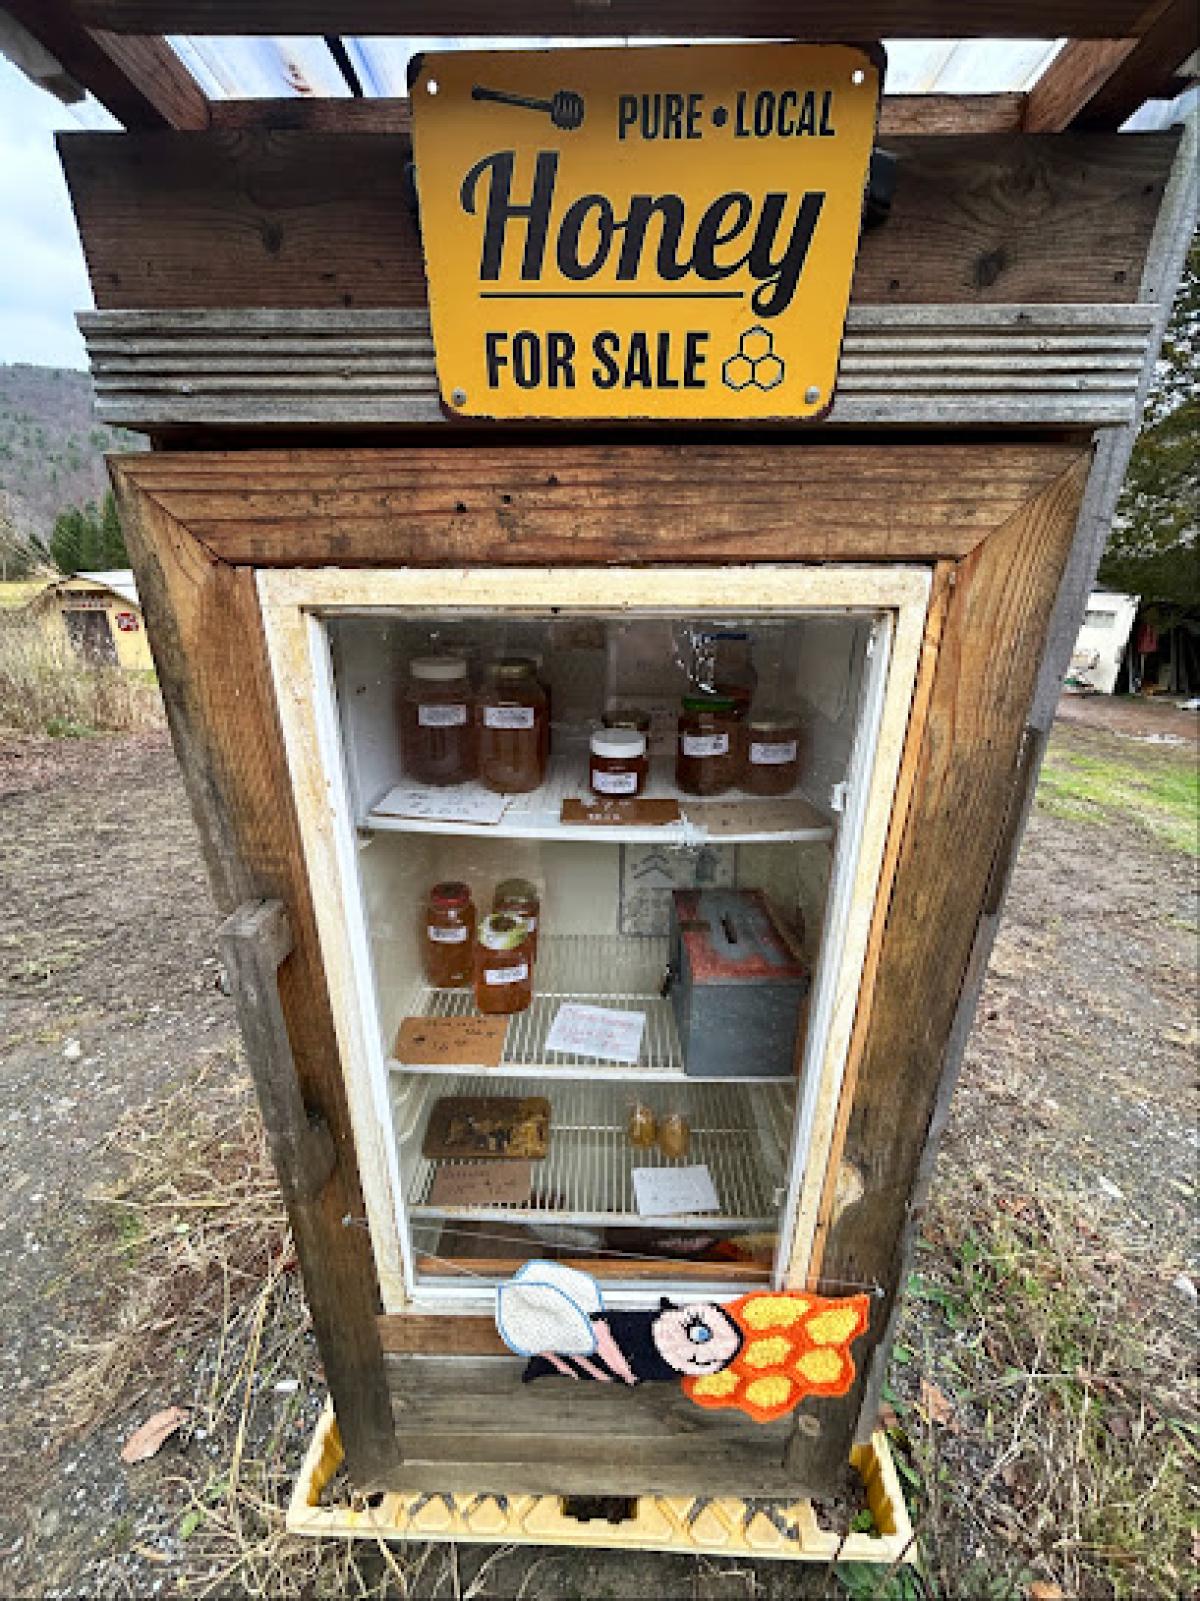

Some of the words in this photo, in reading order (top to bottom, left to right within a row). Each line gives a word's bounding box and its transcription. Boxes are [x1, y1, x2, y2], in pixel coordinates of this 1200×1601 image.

[618, 93, 704, 140] PURE
[735, 91, 835, 137] LOCAL
[460, 151, 826, 318] Honey
[485, 331, 576, 388] FOR
[592, 331, 710, 388] SALE
